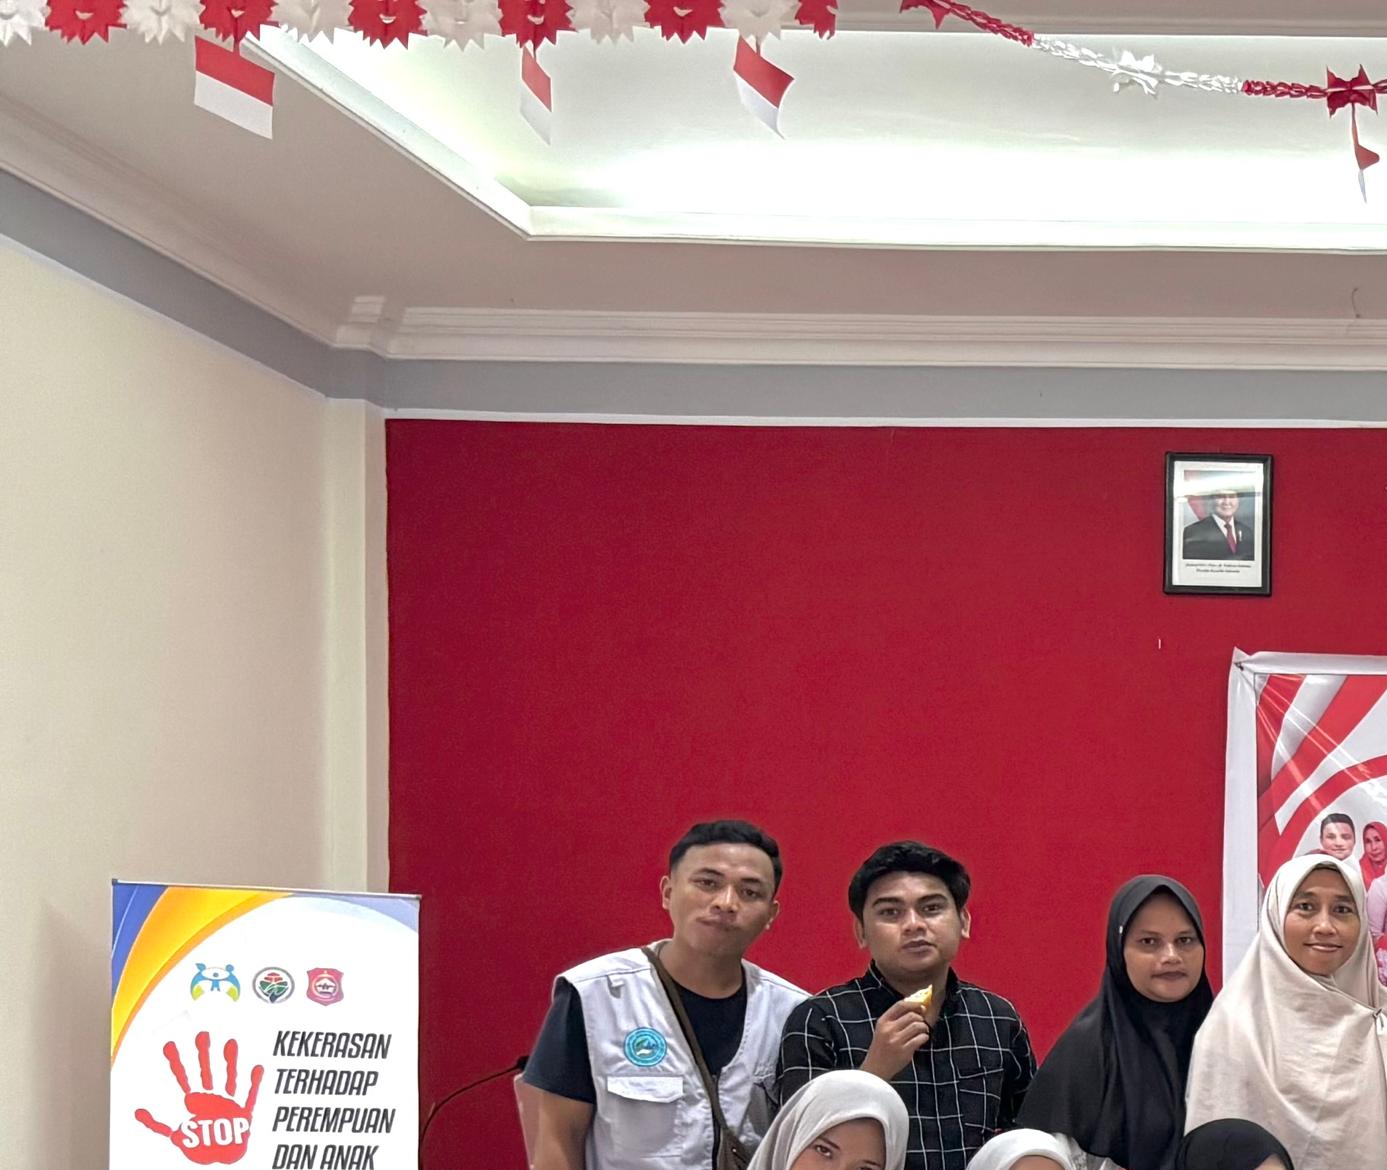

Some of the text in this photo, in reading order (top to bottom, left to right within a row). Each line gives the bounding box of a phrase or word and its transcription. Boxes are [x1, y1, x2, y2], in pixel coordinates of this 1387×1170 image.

[272, 1030, 392, 1060] KEKERASAN
[274, 1068, 379, 1096] TERHADAP
[182, 1117, 251, 1149] STOP
[272, 1106, 396, 1134] PEREMPUAN
[272, 1144, 379, 1170] DAN ANAK
